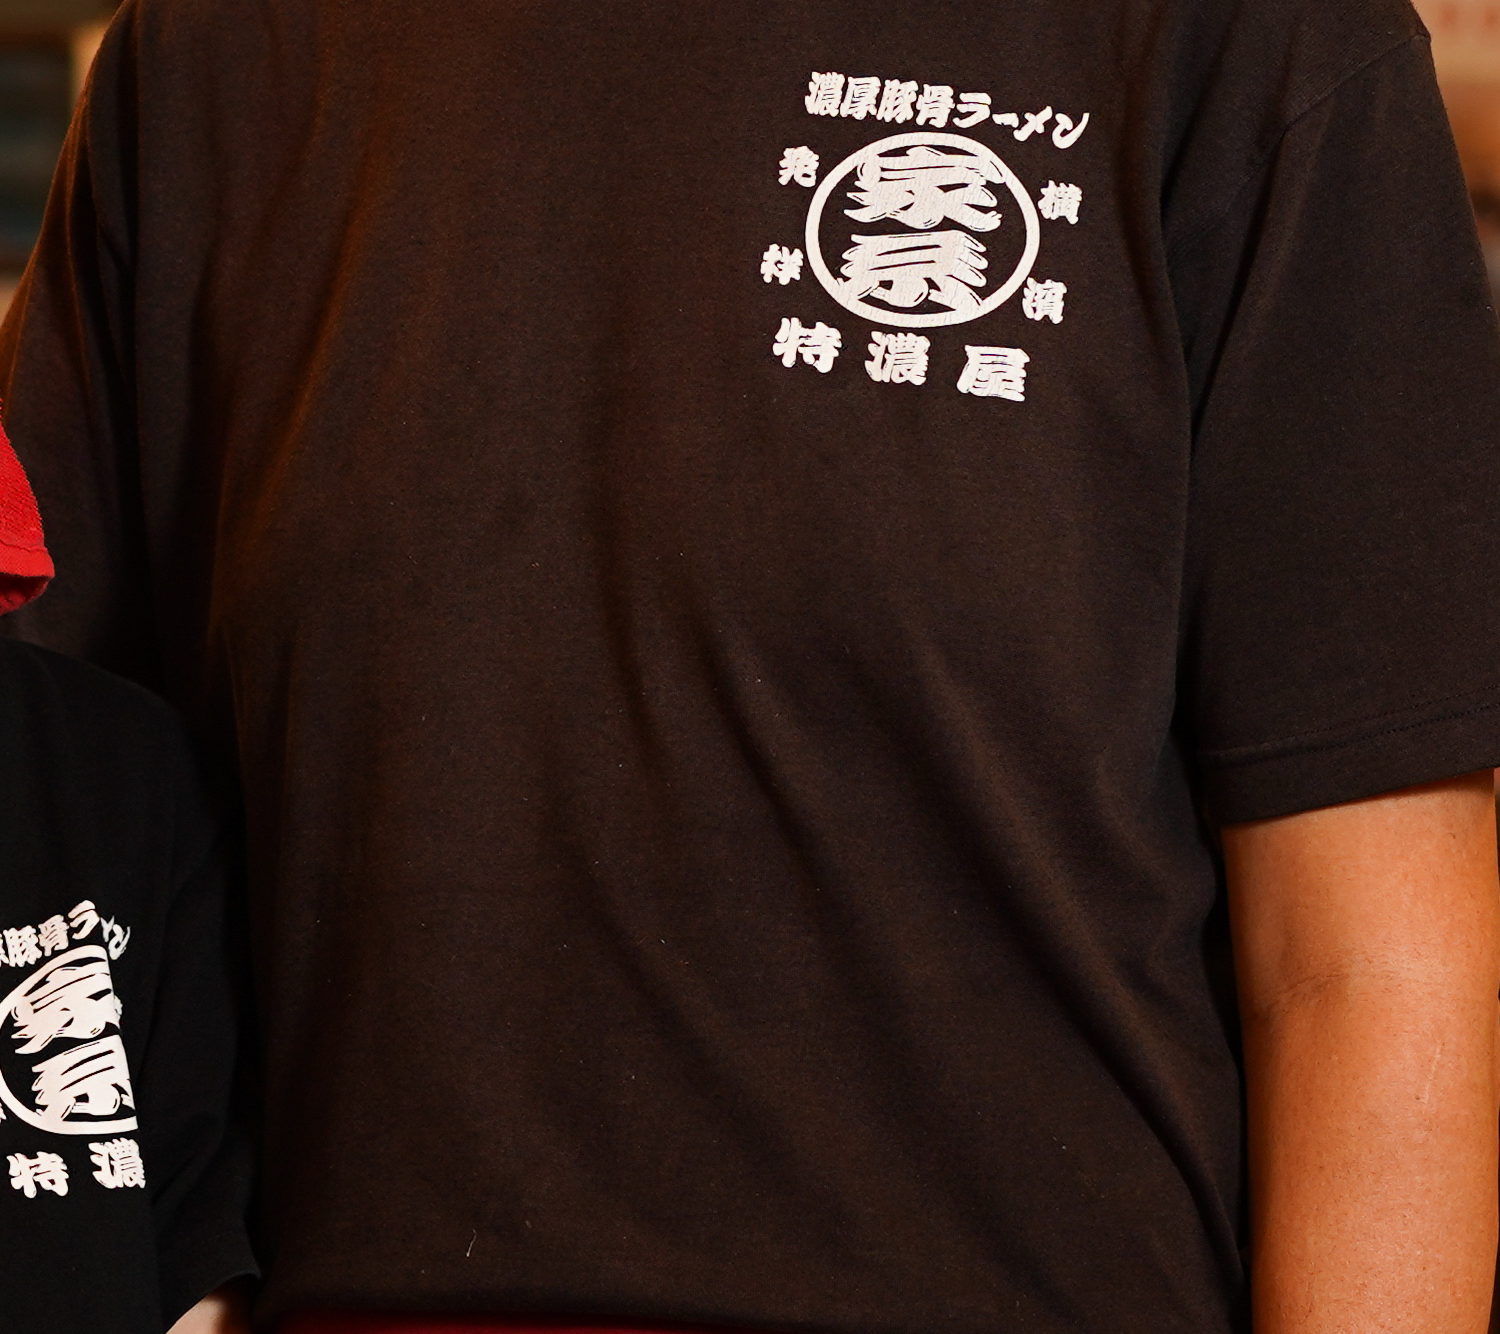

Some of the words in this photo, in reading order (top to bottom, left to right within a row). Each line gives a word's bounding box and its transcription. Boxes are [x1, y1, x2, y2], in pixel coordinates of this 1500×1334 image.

[804, 71, 1091, 150] 濃厚豚骨ラーメン
[772, 316, 1031, 403] 特濃屋
[6, 1137, 147, 1200] 特濃
